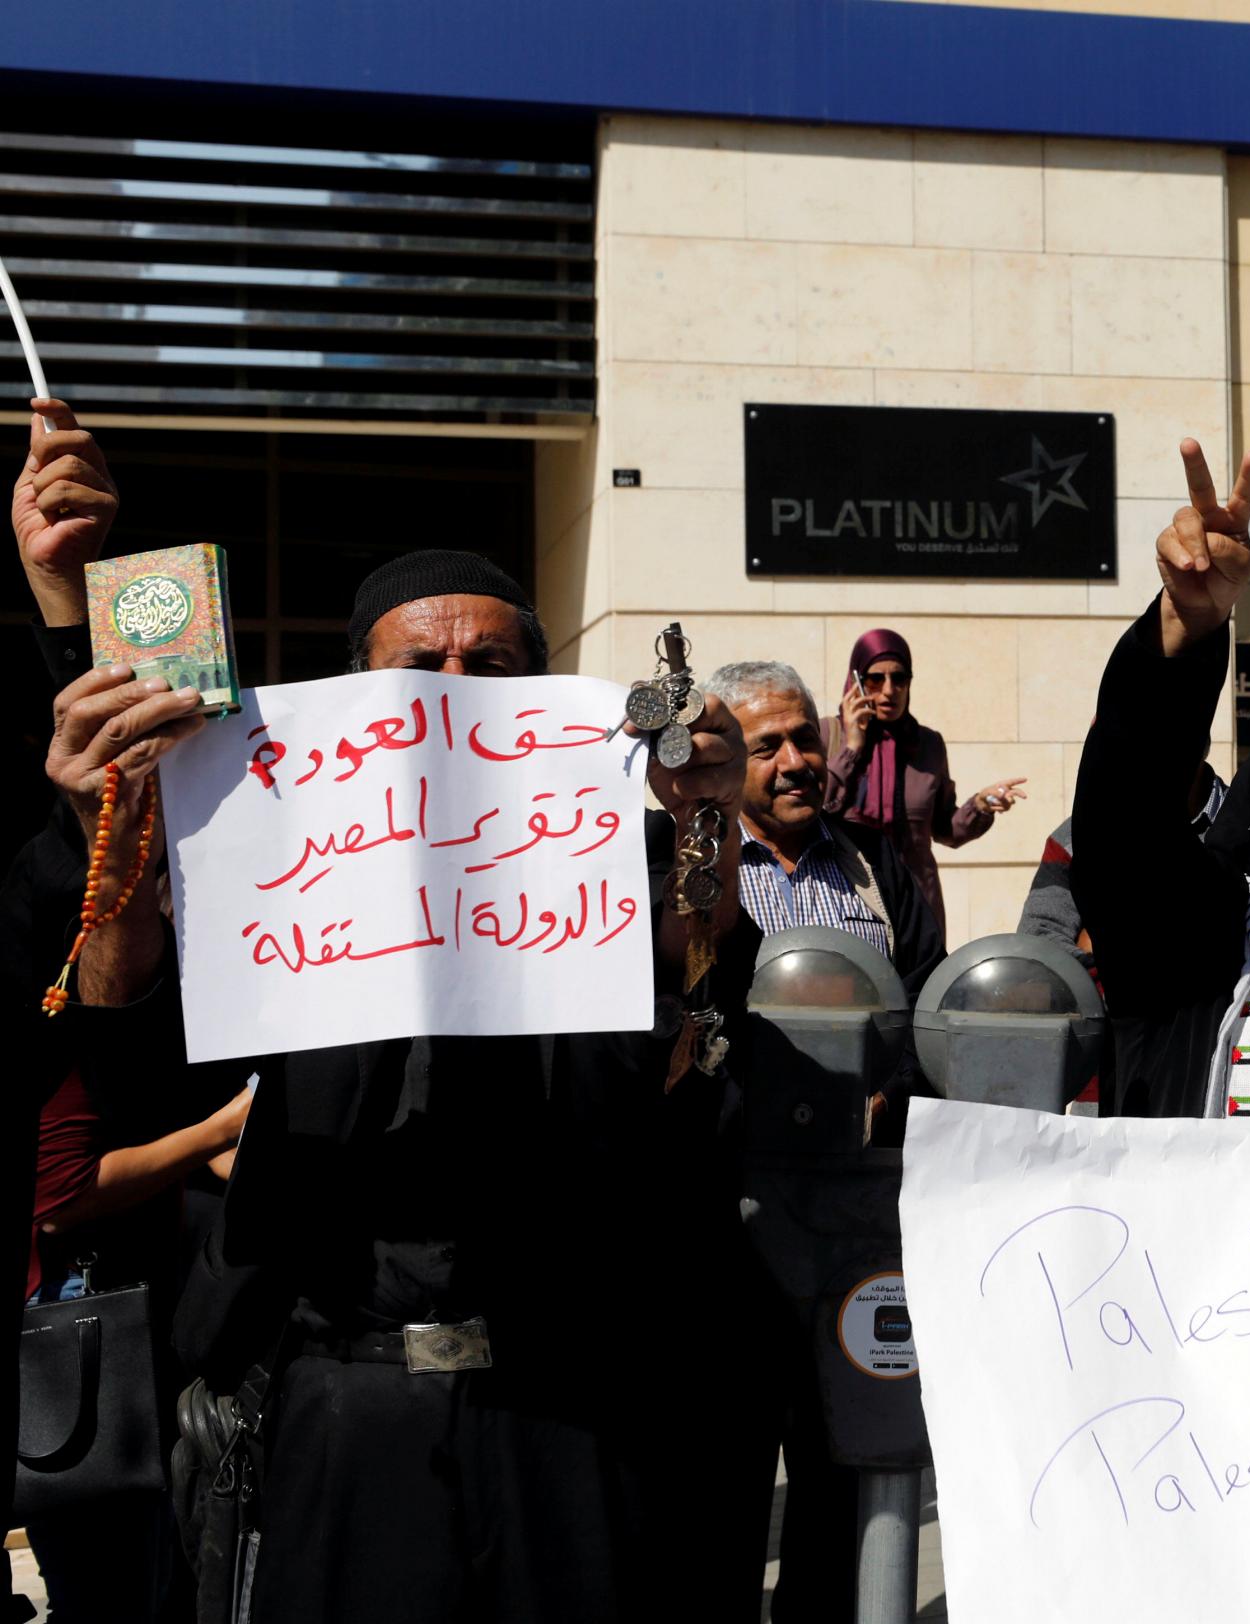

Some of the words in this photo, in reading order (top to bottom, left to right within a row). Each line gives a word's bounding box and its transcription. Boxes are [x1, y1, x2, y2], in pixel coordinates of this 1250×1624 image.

[770, 496, 1020, 541] PLATINUM
[896, 542, 917, 553] YOU
[918, 542, 963, 554] DESERVE
[247, 692, 453, 790] العودة
[468, 709, 609, 761] حق
[255, 776, 428, 893] المصير
[242, 885, 463, 973] المستقلة
[472, 879, 637, 953] والدولة
[886, 1348, 914, 1356] Palestine
